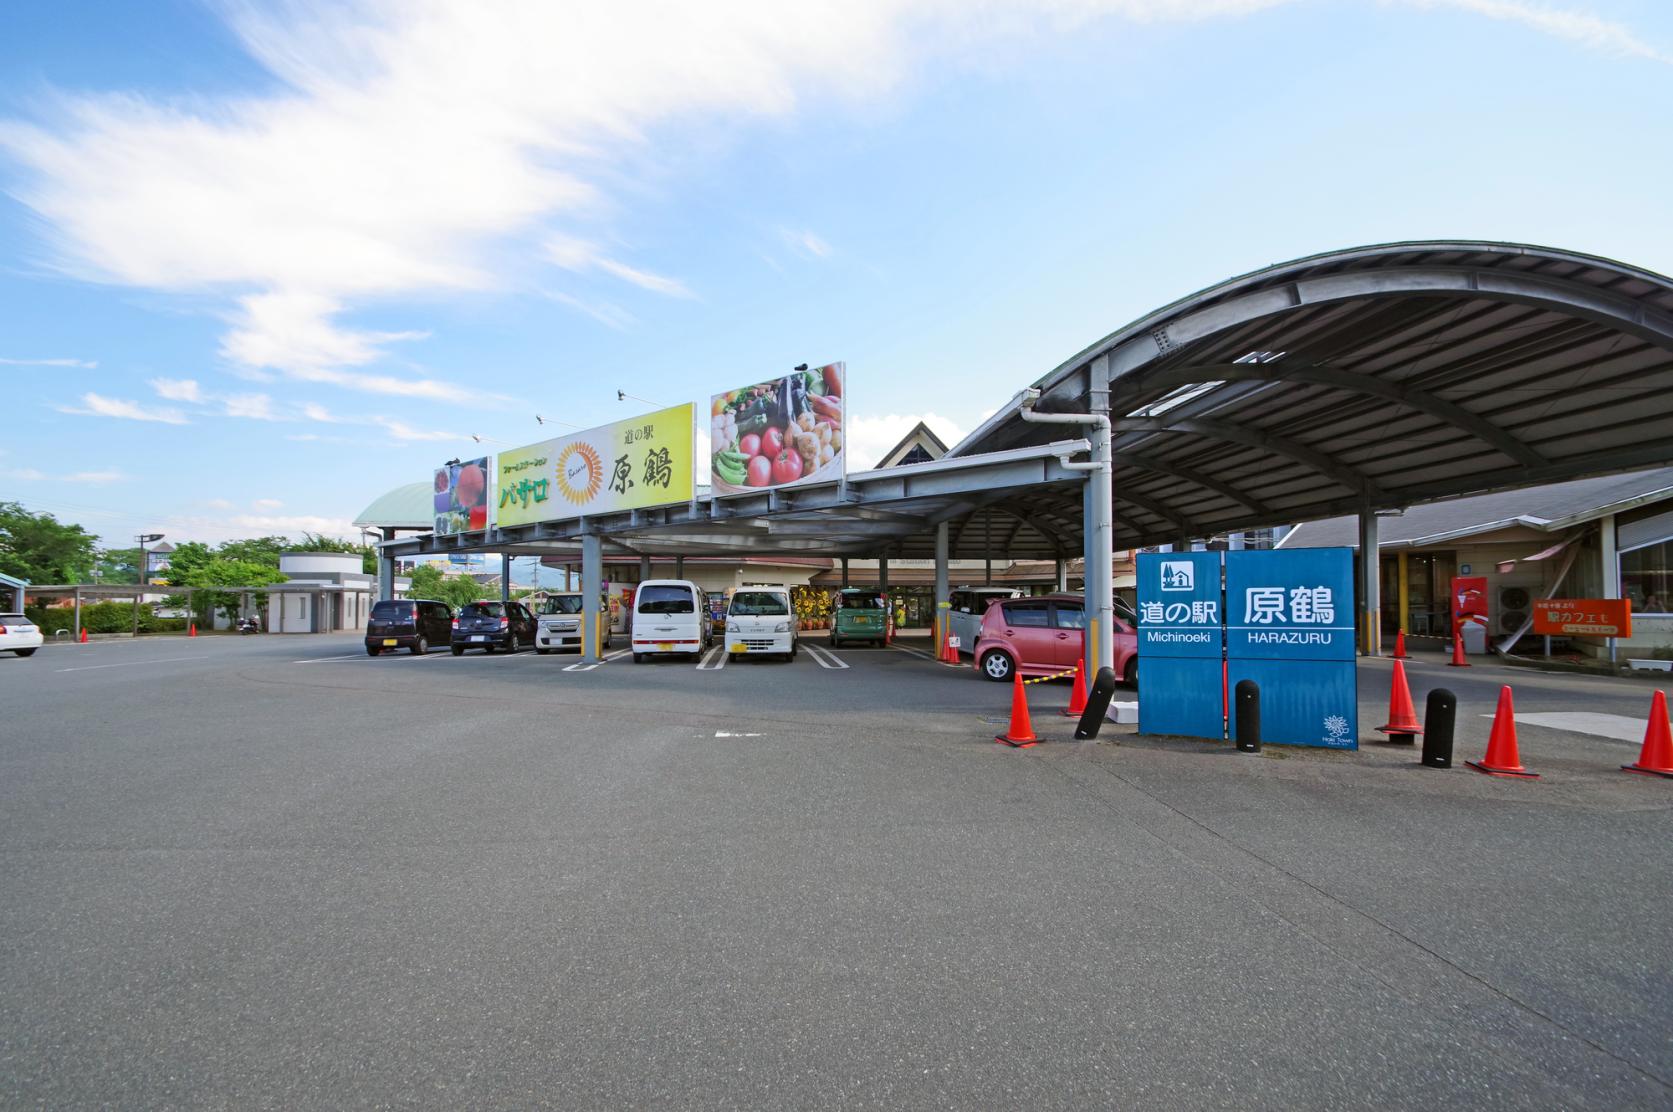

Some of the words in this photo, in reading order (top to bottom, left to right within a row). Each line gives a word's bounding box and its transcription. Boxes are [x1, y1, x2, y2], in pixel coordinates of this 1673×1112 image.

[624, 424, 654, 444] 道の駅
[608, 446, 673, 496] 原鶴
[499, 478, 549, 509] バサロ
[1140, 601, 1218, 624] 道の駅
[1244, 585, 1335, 625] 原鶴
[1147, 631, 1211, 643] Michinoeki
[1247, 632, 1332, 644] HARAZURU
